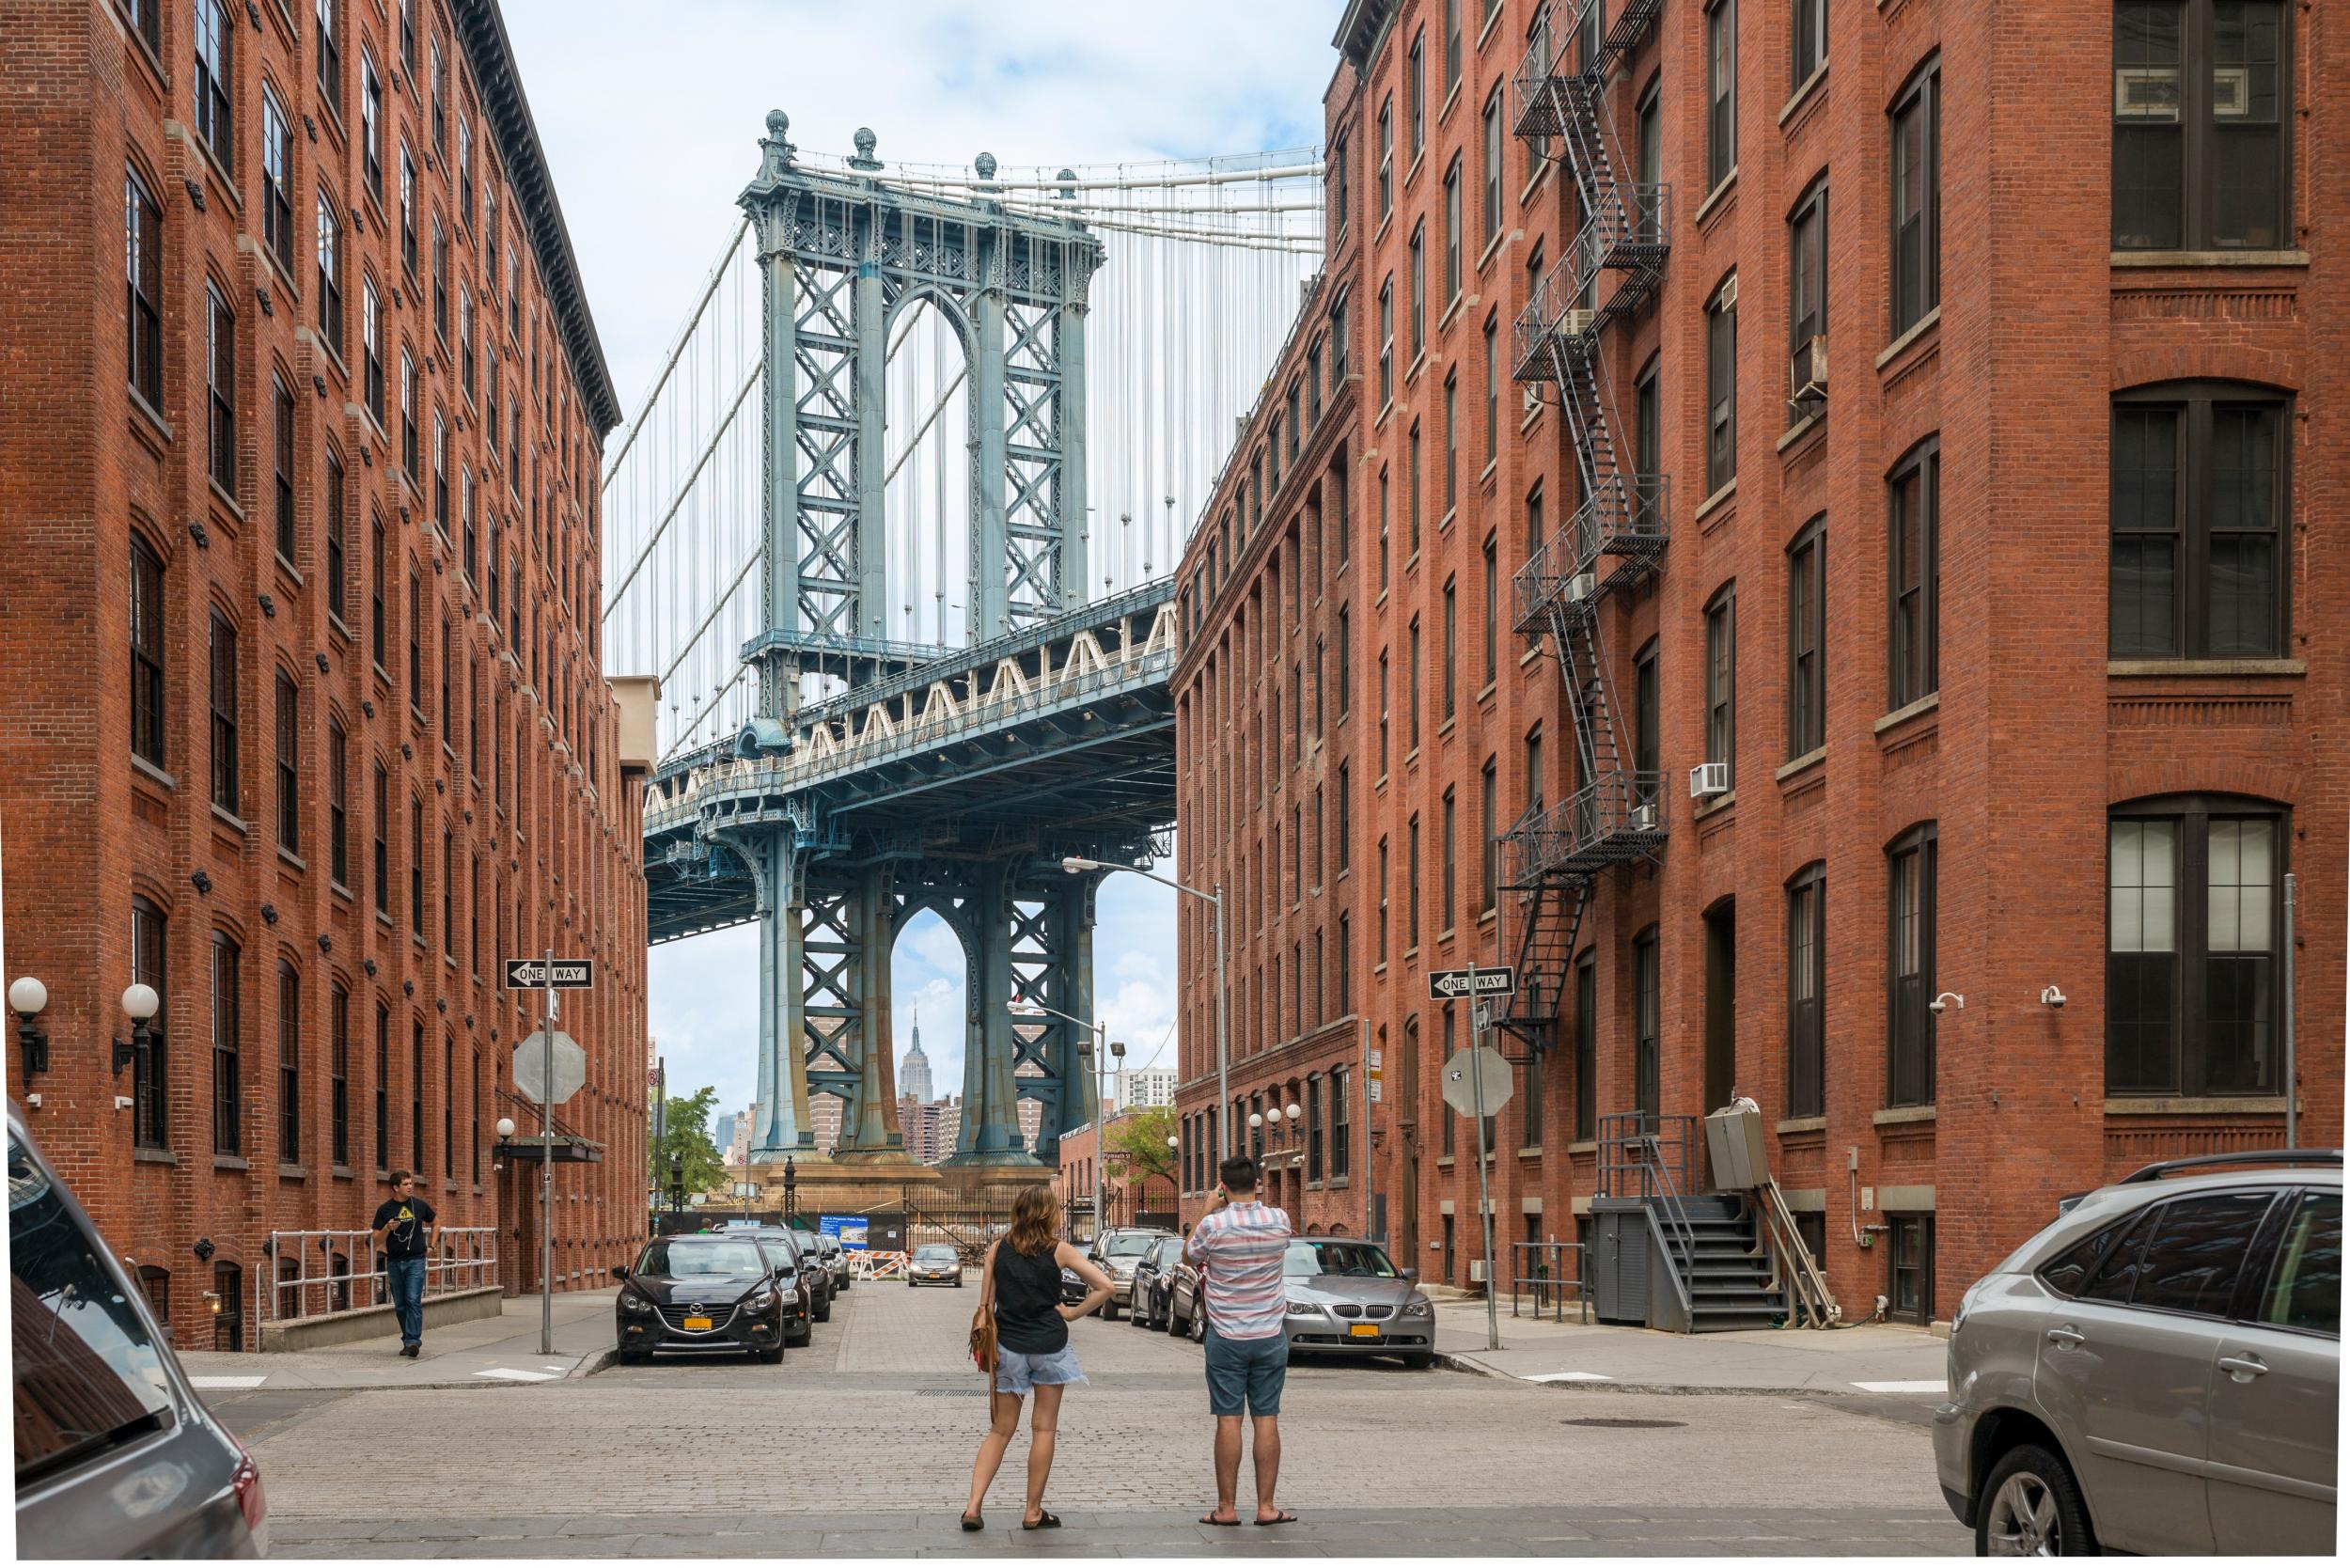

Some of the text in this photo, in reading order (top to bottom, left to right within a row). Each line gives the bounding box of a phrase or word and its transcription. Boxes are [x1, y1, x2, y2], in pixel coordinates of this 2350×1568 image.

[520, 968, 581, 980] ONE WAY
[1443, 976, 1502, 990] ONE WAY
